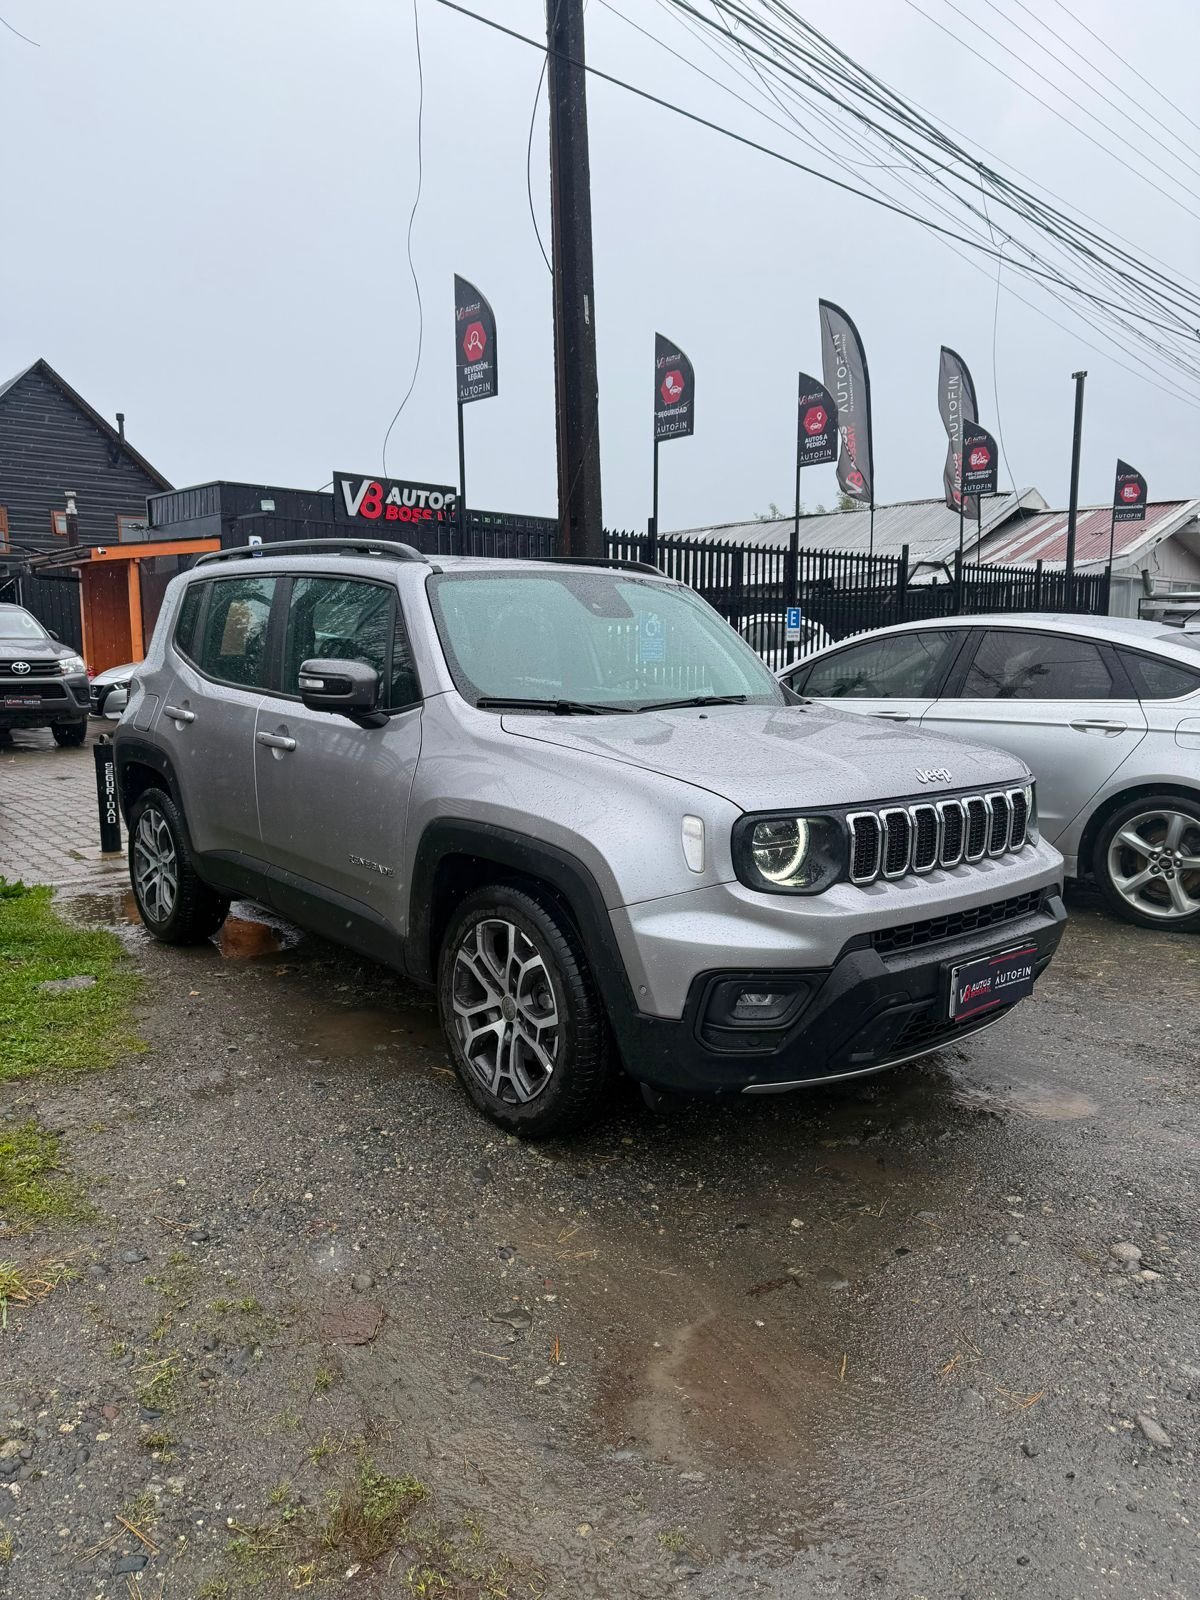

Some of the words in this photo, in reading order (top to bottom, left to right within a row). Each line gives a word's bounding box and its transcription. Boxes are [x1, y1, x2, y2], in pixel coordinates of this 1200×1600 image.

[467, 371, 483, 381] LEGAL
[833, 334, 848, 413] AUTOFIN
[460, 382, 490, 398] AUTOFIN
[658, 406, 687, 418] SEGURIDAD
[947, 375, 959, 441] AUTOFIN
[656, 420, 687, 434] AUTOFIN
[805, 435, 822, 443] AUTOS
[806, 440, 826, 449] PEDIDO
[800, 449, 832, 461] AUTOFIN
[963, 483, 992, 491] AUTOFIN
[341, 479, 384, 519] V8
[790, 610, 797, 626] E
[914, 768, 953, 785] Jeep
[104, 762, 117, 824] SEGURIDAD
[960, 984, 971, 1004] V8
[971, 978, 992, 992] AUTOS
[994, 965, 1032, 985] AUTOFIN
